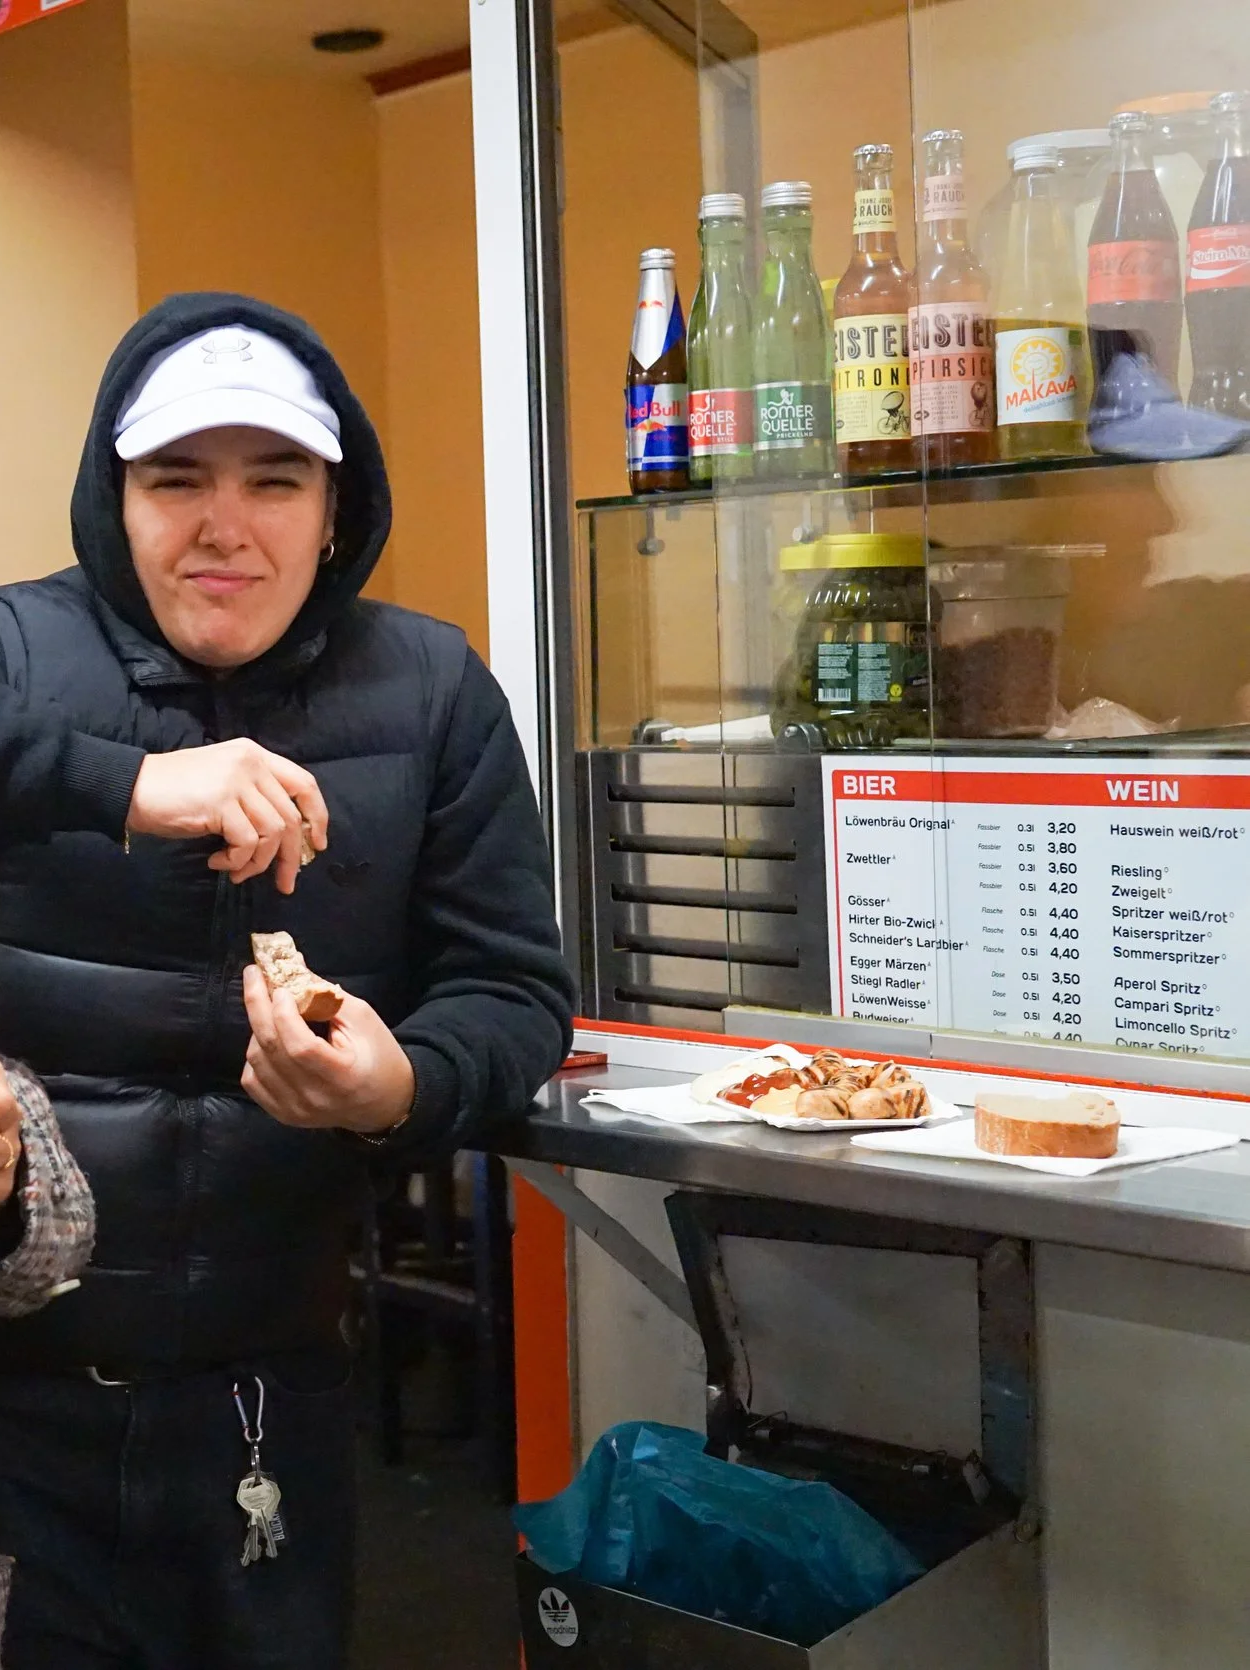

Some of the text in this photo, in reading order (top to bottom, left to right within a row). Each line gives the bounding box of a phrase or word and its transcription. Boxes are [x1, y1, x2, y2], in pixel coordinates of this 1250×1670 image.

[859, 204, 893, 217] RAUCH
[912, 356, 992, 381] PFIRSIC
[838, 367, 909, 389] ITRON
[651, 401, 681, 417] Bull
[690, 422, 734, 441] QUELLE
[761, 418, 813, 436] QUELLE
[842, 775, 896, 796] BIER
[1106, 780, 1179, 802] WEIN
[845, 815, 905, 828] Löwenbräu
[1047, 822, 1076, 835] 3,20
[1110, 824, 1174, 837] Hauswein
[1047, 842, 1077, 854] 3,80
[1048, 862, 1077, 875] 3,60
[1049, 882, 1078, 895] 4,20
[1049, 907, 1079, 920] 4,40
[1112, 905, 1165, 919] Spritzer
[848, 914, 880, 926] Hirter
[849, 932, 913, 946] Schneider's
[1050, 927, 1079, 940] 4,40
[1050, 947, 1080, 960] 4,40
[850, 956, 881, 970] Egger
[851, 974, 881, 989] Stiegl
[1051, 972, 1081, 985] 3,50
[1114, 976, 1157, 991] Aperol
[1052, 992, 1081, 1005] 4,20
[1114, 996, 1169, 1013] Campari
[1052, 1012, 1082, 1025] 4,20
[1115, 1016, 1186, 1035] Limoncello
